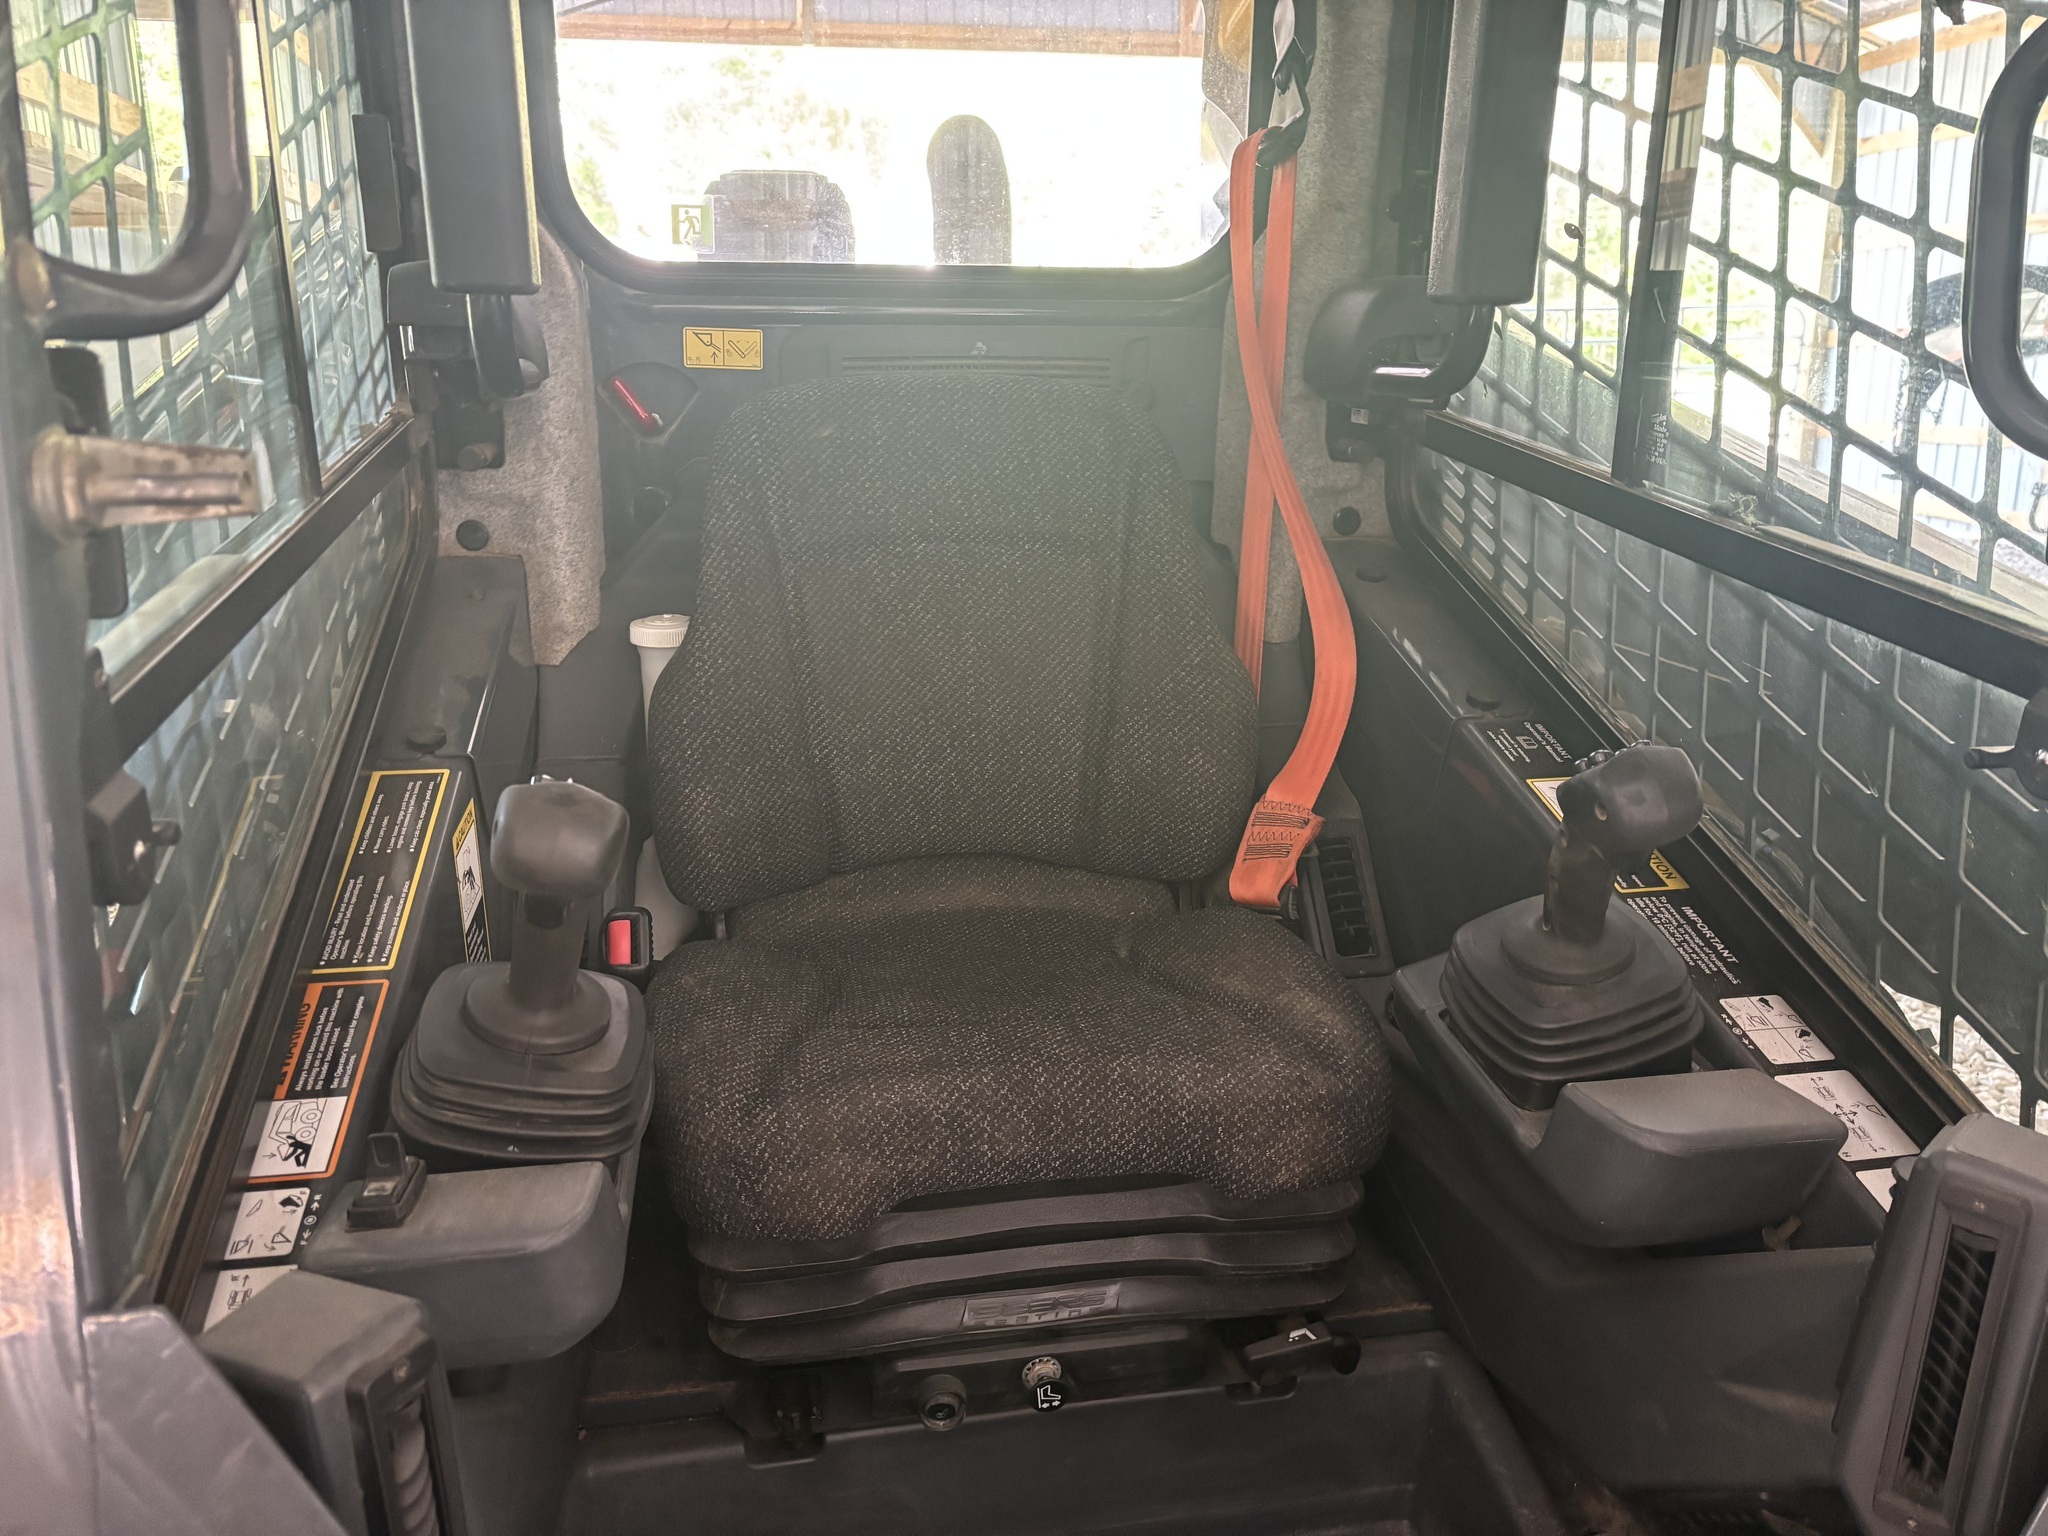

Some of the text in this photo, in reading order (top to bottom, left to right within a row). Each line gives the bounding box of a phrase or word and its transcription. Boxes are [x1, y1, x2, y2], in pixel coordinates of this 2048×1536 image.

[1534, 724, 1572, 760] IMPORTANT
[358, 926, 368, 944] location
[366, 898, 377, 917] function
[373, 931, 382, 945] safety
[377, 913, 386, 930] devices
[382, 944, 391, 956] Keep
[387, 926, 396, 944] screens
[395, 898, 404, 917] windows
[1634, 898, 1645, 907] idle
[1657, 924, 1678, 946] minutes
[1677, 947, 1694, 965] before
[1642, 897, 1658, 912] below
[1681, 942, 1692, 952] run
[1696, 960, 1711, 974] slow
[1650, 897, 1663, 906] and
[1683, 934, 1717, 970] temperatures
[1664, 904, 1686, 923] prevent
[1683, 924, 1704, 946] damage
[1709, 954, 1740, 984] hydraulics
[1682, 906, 1738, 963] IMPORTANT
[368, 945, 377, 957] Keep
[353, 996, 364, 1019] complete
[295, 1007, 328, 1090] Always install boom lock before
[306, 1068, 319, 1090] working
[319, 1032, 329, 1051] around
[324, 1022, 333, 1032] this
[329, 1000, 340, 1021] machine
[315, 1027, 340, 1089] the loader boom raised.
[343, 1028, 354, 1047] Manual
[330, 1078, 340, 1088] See
[334, 1048, 348, 1076] Operator's
[341, 1054, 356, 1087] instructions.
